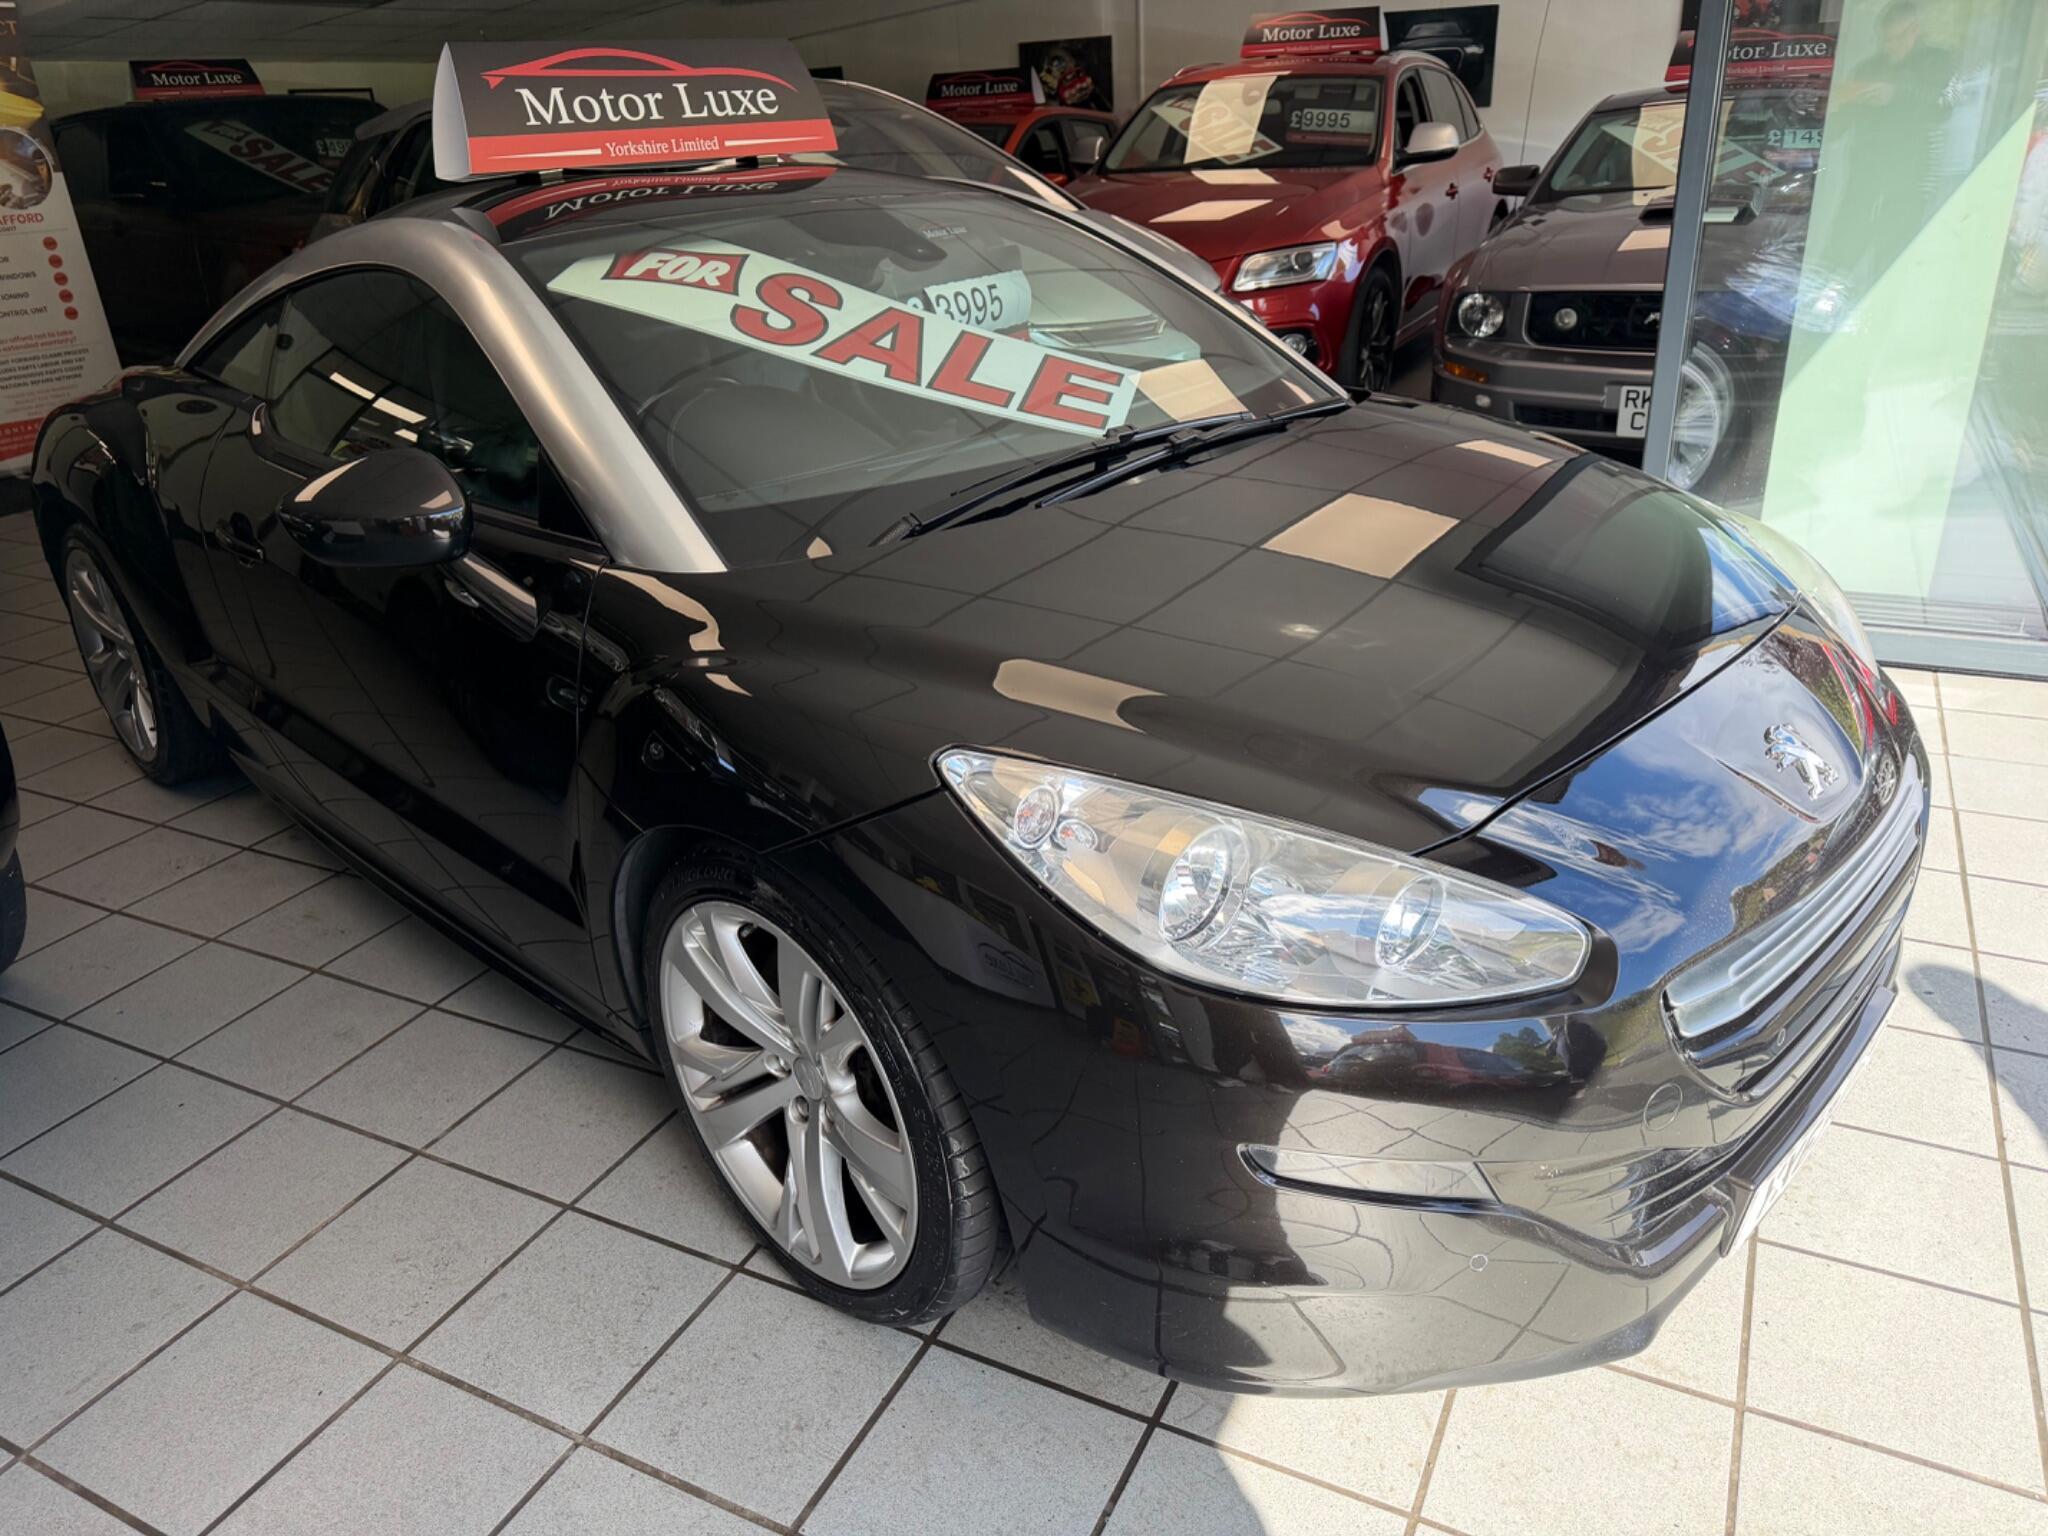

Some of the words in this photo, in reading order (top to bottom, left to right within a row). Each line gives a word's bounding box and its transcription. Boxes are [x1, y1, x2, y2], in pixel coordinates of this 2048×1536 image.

[1262, 27, 1314, 42] Motor
[1318, 24, 1360, 38] Luxe
[1728, 45, 1765, 60] tor
[1770, 41, 1827, 58] Luxe
[150, 72, 201, 86] Motor
[202, 71, 243, 84] Luxe
[941, 84, 982, 97] Motor
[985, 81, 1018, 94] Luxe
[515, 85, 664, 126] Motor
[672, 82, 779, 119] Luxe
[1289, 109, 1352, 128] £9995
[605, 139, 669, 157] Yorkshire
[671, 136, 720, 153] Limited
[624, 251, 732, 287] FOR
[730, 273, 1124, 430] SALE
